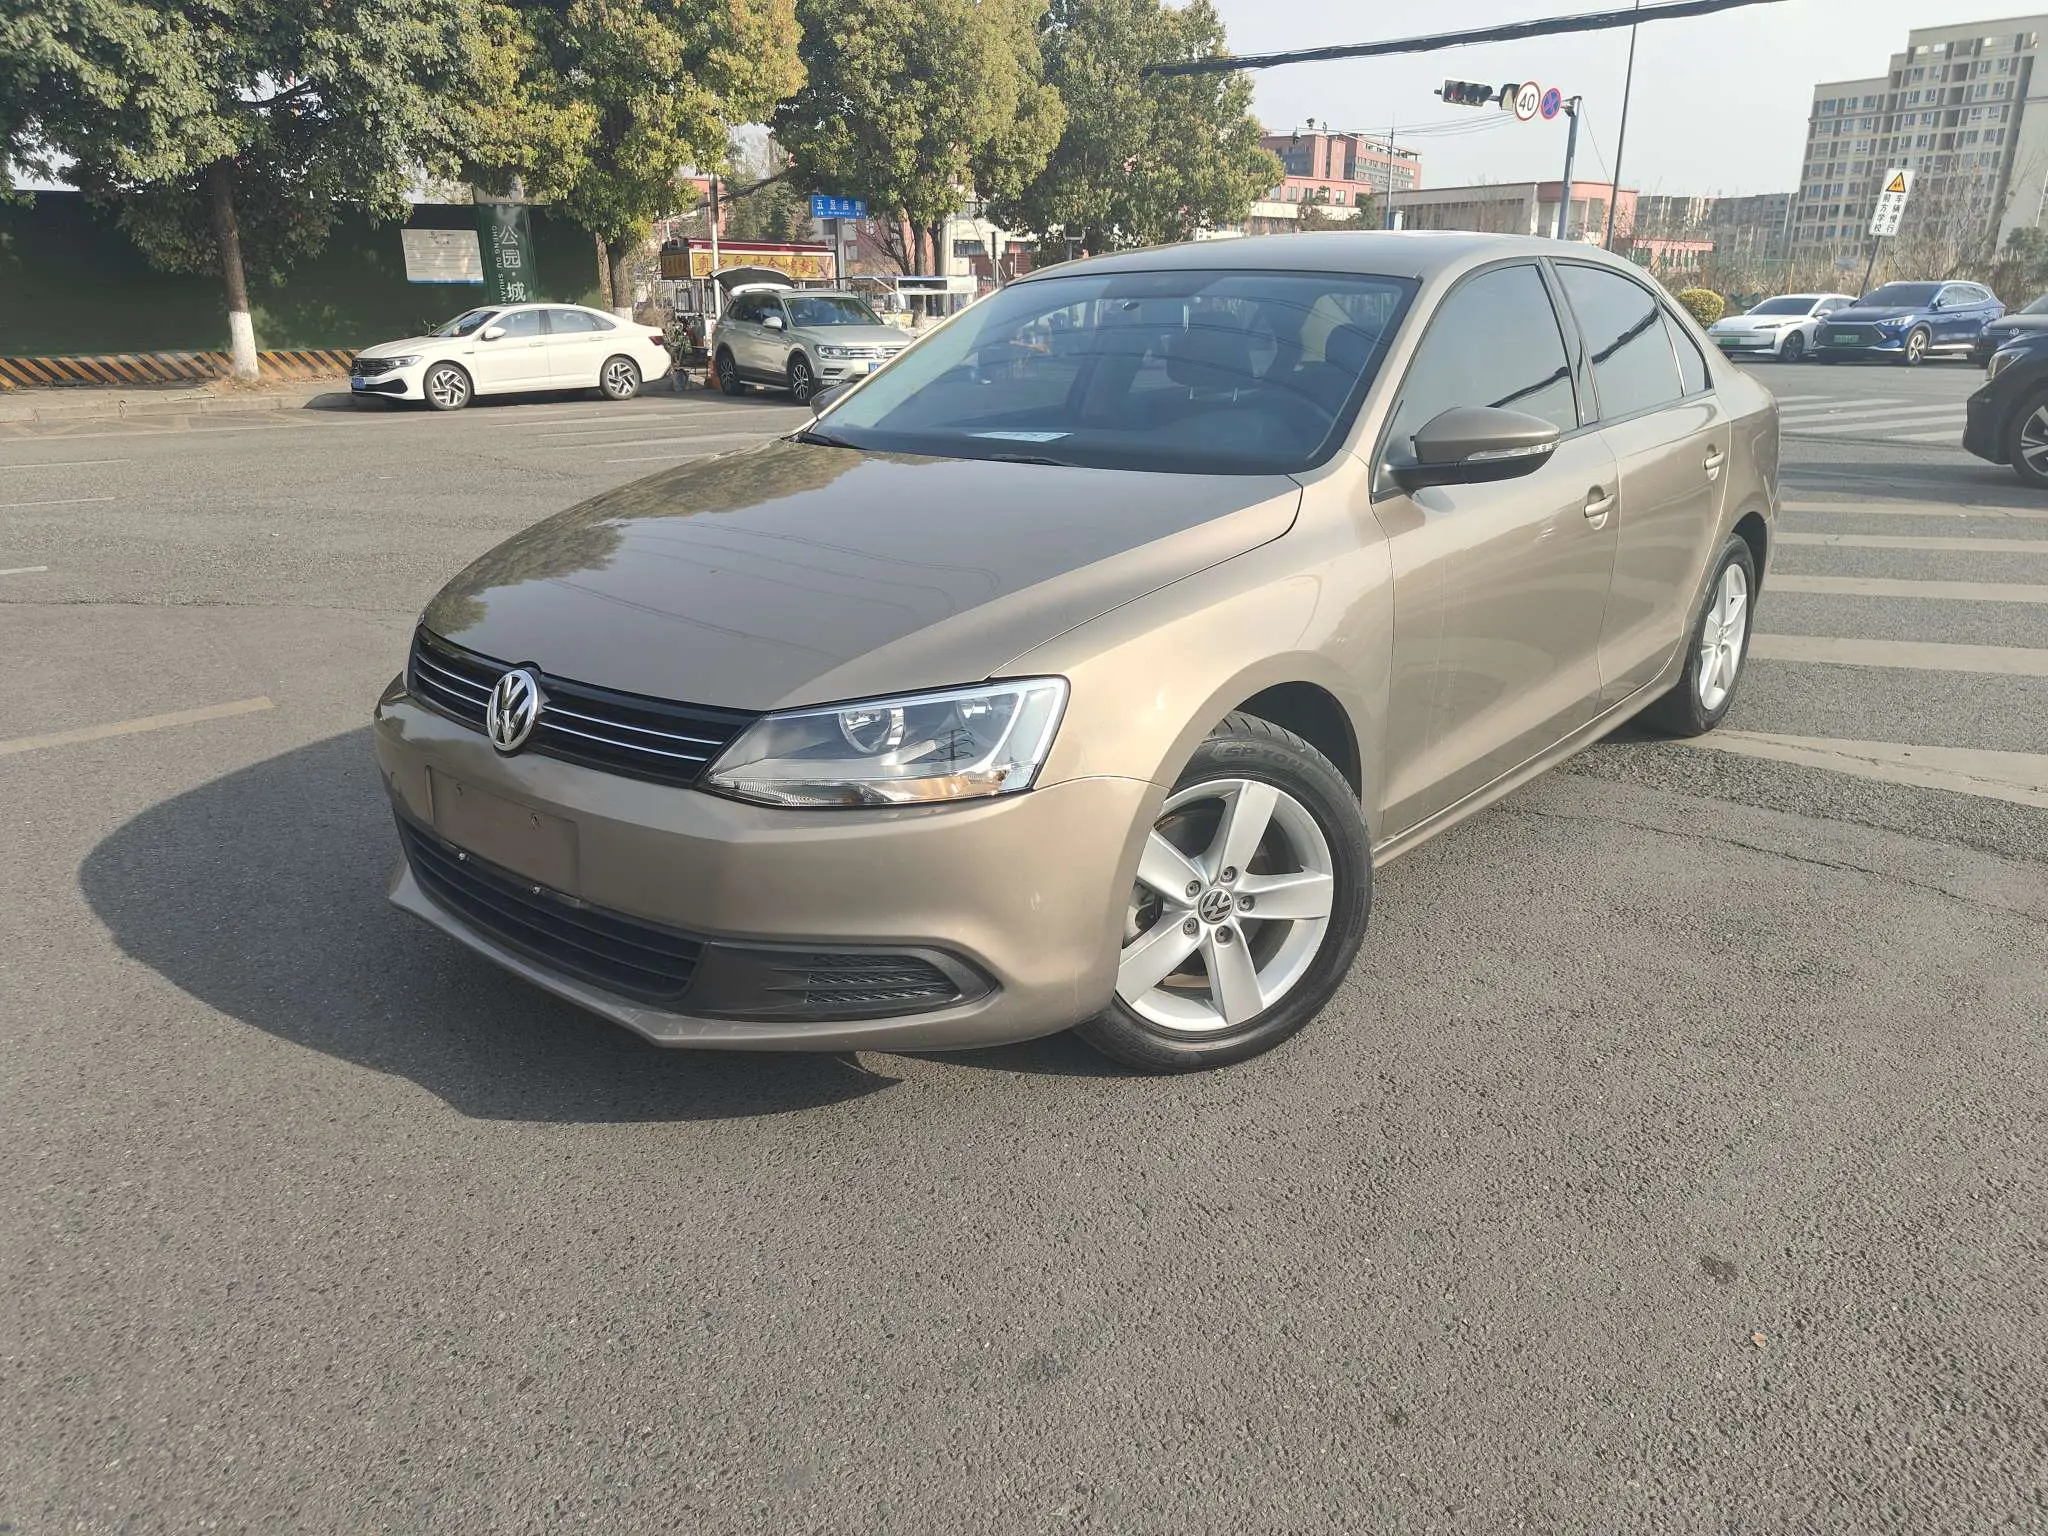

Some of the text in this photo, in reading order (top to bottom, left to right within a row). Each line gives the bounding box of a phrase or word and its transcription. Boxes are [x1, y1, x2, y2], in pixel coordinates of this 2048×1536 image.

[1519, 94, 1536, 111] 40
[1873, 193, 1892, 233] 前方学校
[1886, 194, 1904, 233] 车辆慢行
